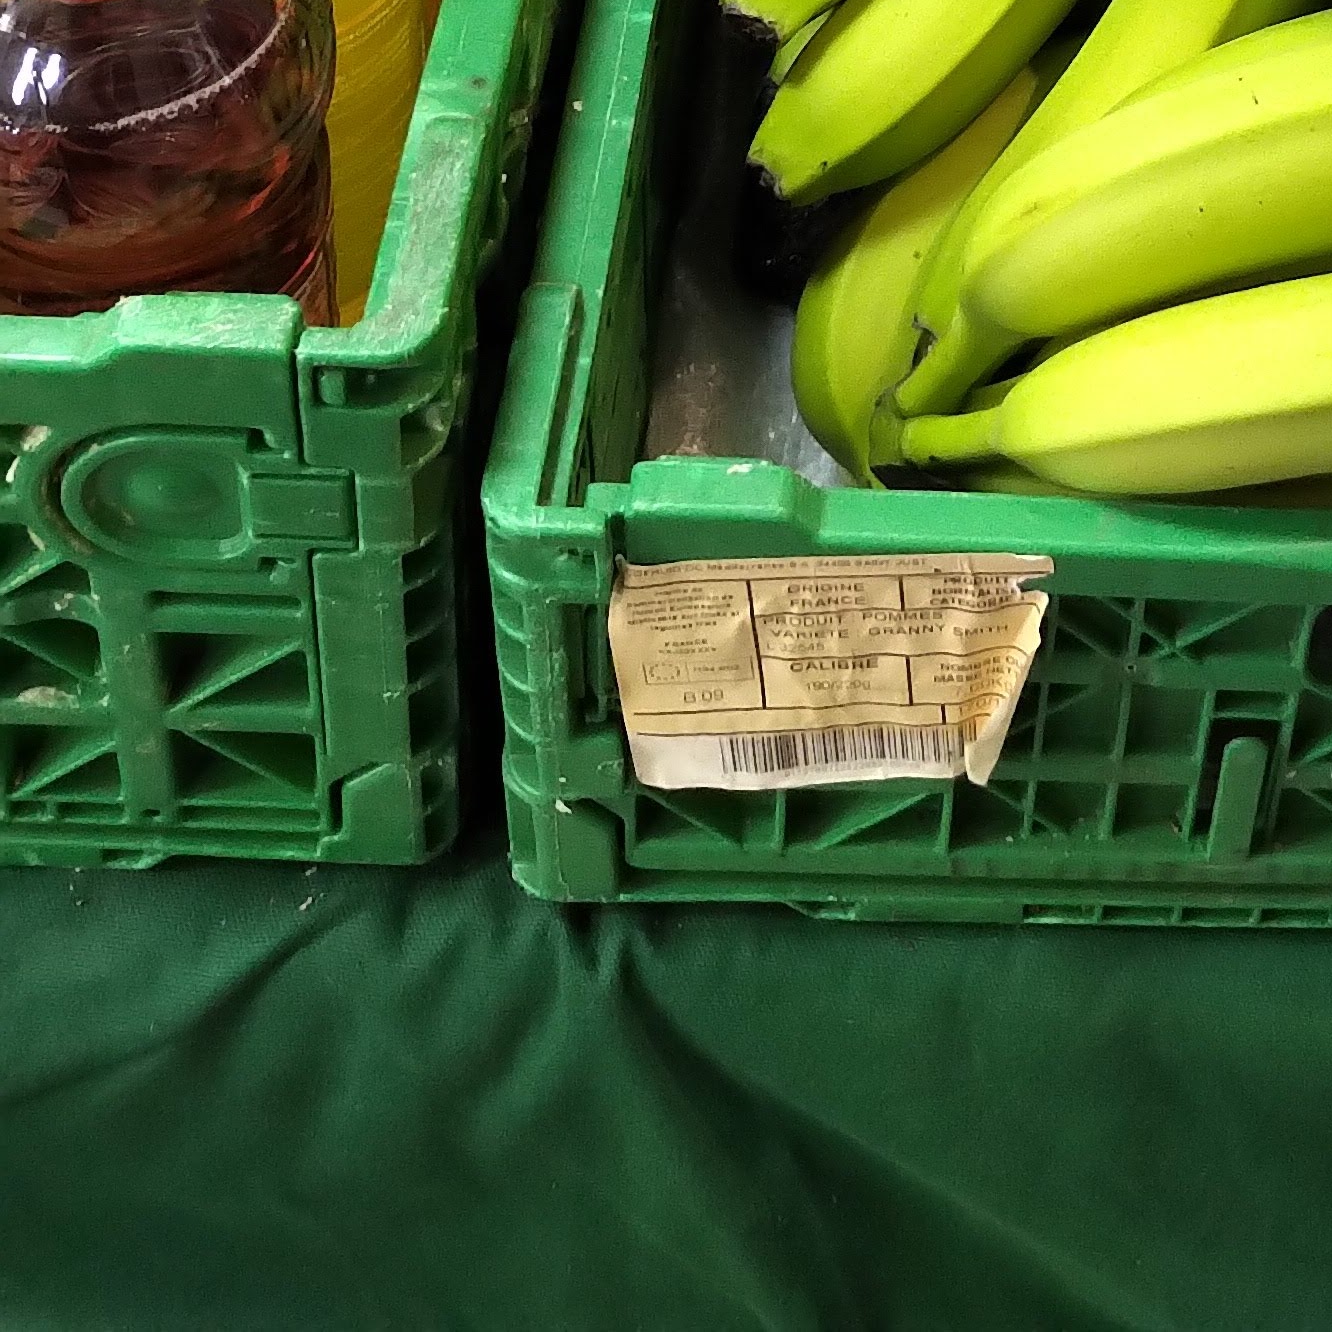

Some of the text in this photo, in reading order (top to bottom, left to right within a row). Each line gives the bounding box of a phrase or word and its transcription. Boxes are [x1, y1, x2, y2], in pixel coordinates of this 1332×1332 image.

[787, 582, 865, 595] ORIGINE
[790, 595, 867, 608] FRANCE
[763, 610, 943, 626] PRODUIT POMMES
[771, 628, 849, 640] VARIETE
[868, 622, 946, 637] GRANNY
[790, 657, 879, 673] CALIBRE
